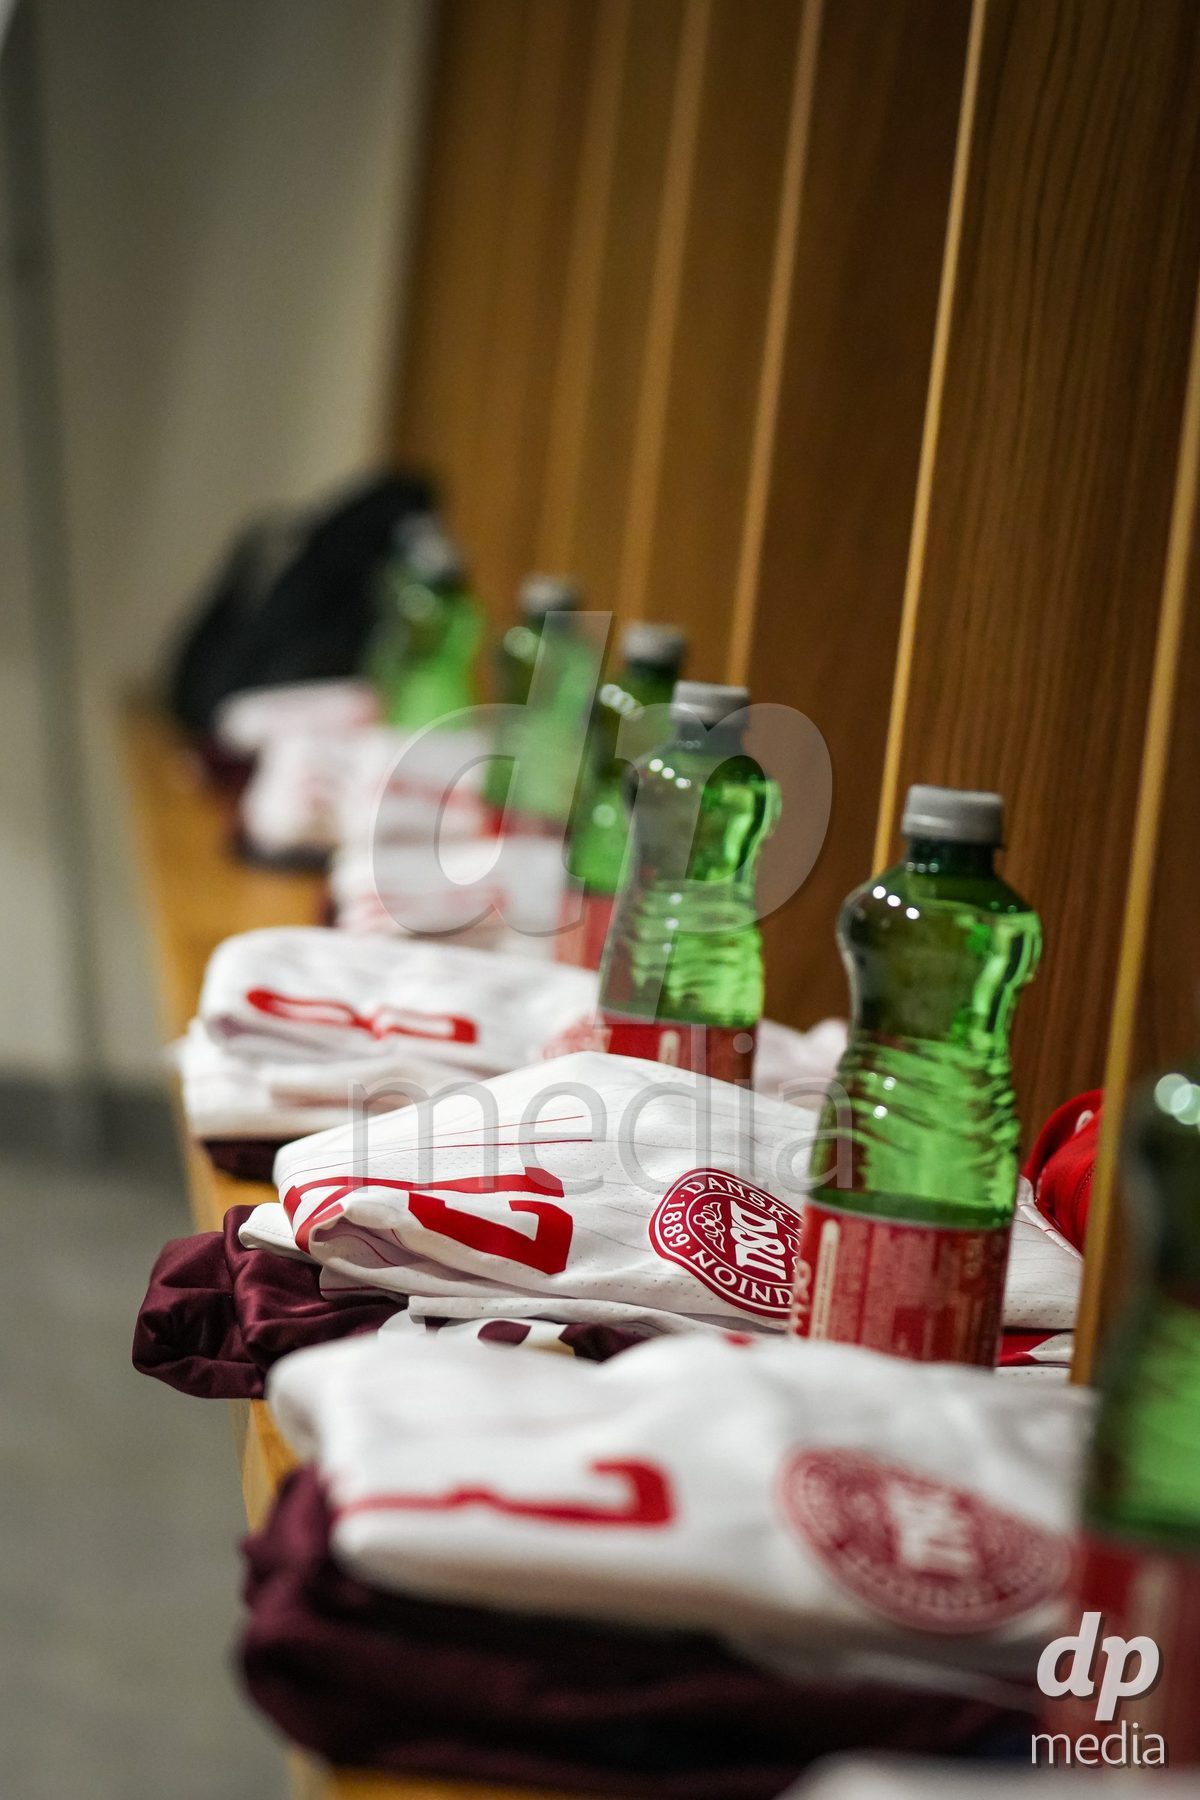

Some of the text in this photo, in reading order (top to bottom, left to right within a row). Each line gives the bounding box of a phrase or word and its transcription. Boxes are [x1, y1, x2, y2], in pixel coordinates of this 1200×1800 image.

[681, 1177, 789, 1222] DANSK
[661, 1200, 691, 1248] 1889
[690, 1248, 793, 1305] UNION
